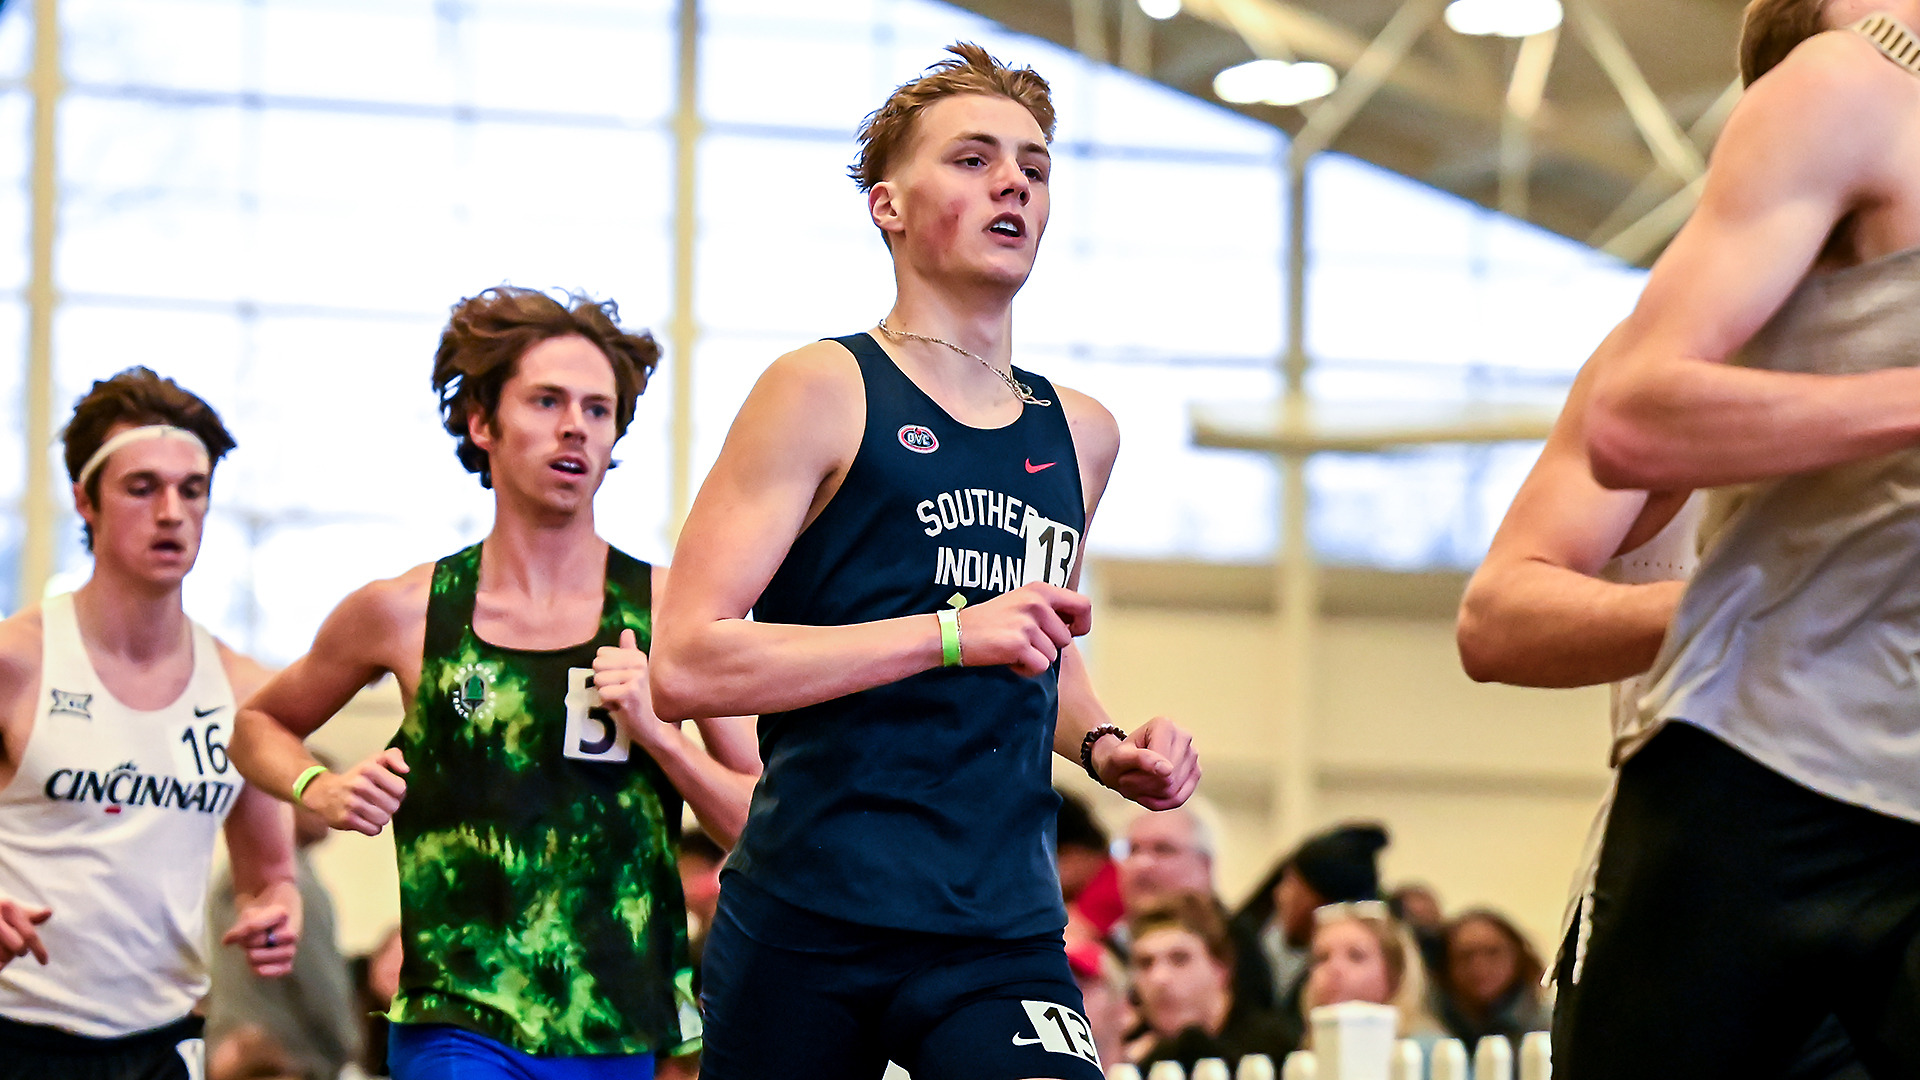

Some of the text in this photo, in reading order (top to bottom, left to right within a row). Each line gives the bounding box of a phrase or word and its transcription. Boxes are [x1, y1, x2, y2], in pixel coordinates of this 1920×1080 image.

[907, 432, 931, 446] OVC
[916, 488, 1042, 538] SOUTHER
[934, 546, 1023, 593] INDIAN
[1039, 525, 1075, 589] 13
[182, 724, 228, 776] 16
[45, 769, 234, 814] CINCINNATI
[1043, 1006, 1098, 1065] 13
